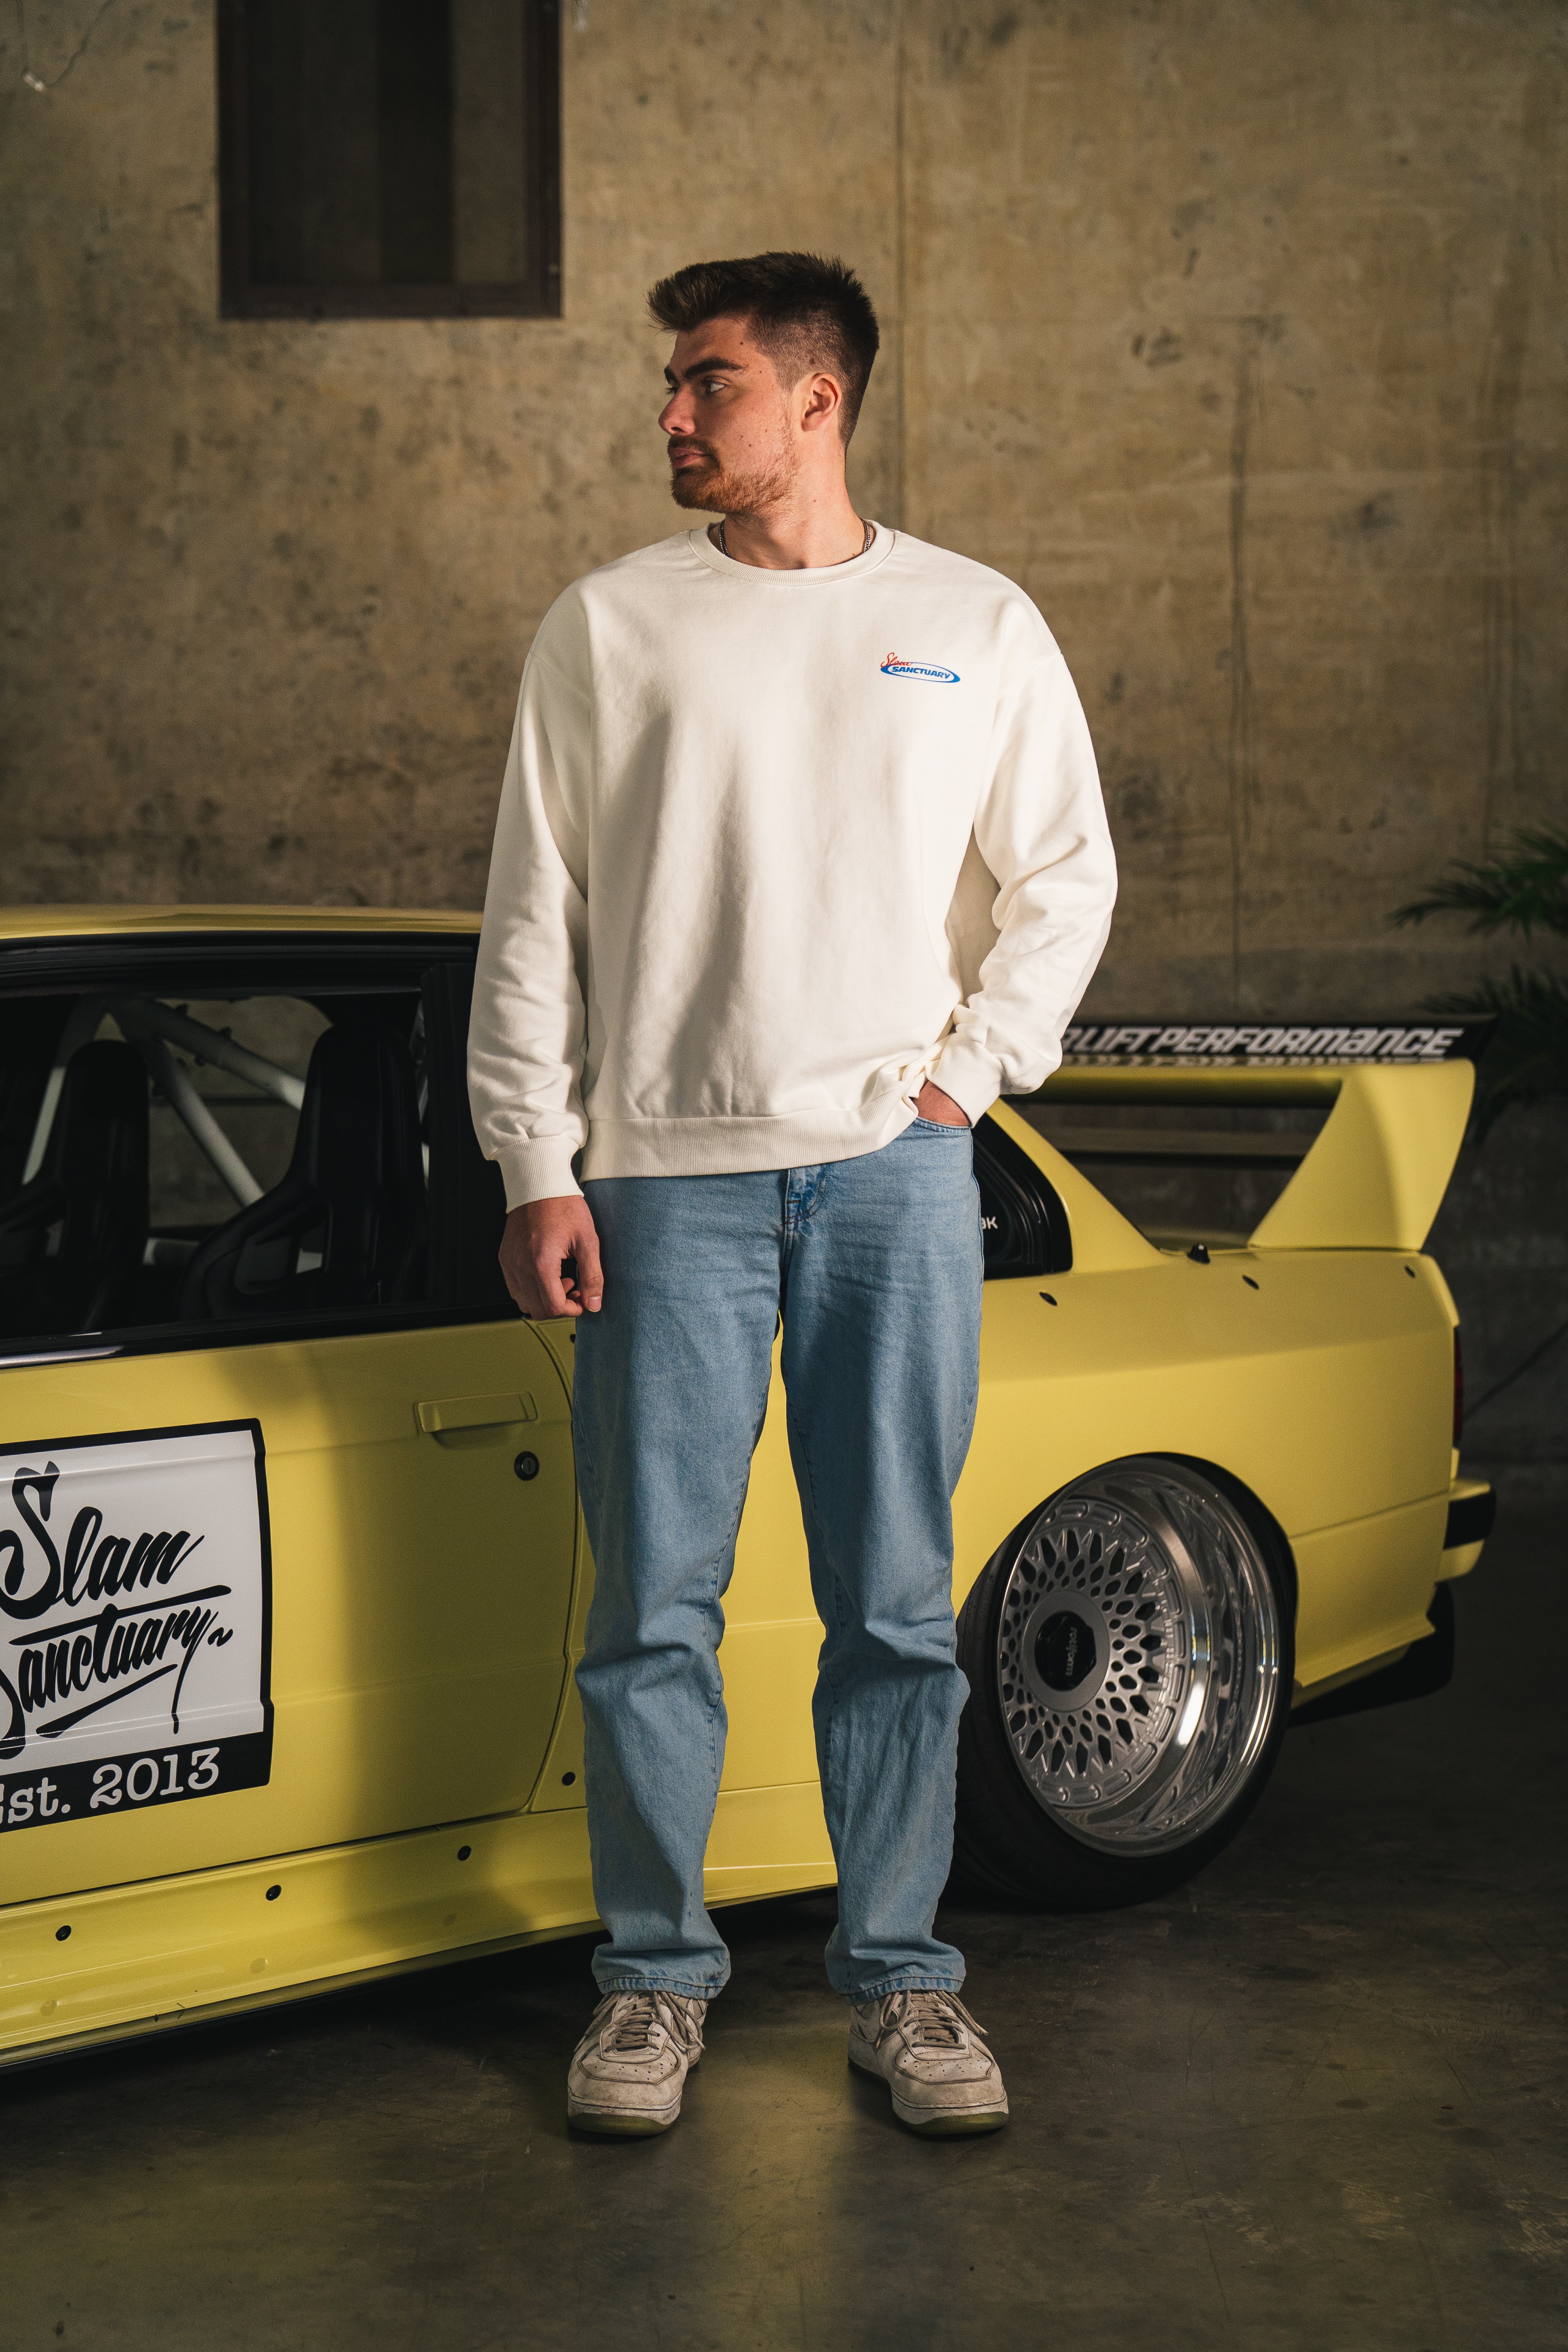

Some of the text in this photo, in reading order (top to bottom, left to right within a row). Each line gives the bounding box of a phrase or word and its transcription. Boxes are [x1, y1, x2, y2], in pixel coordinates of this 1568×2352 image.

[880, 652, 913, 668] Slam
[892, 666, 951, 679] SANCTUARY
[0, 1461, 205, 1620] Slam
[0, 1747, 220, 1824] st. 2013
